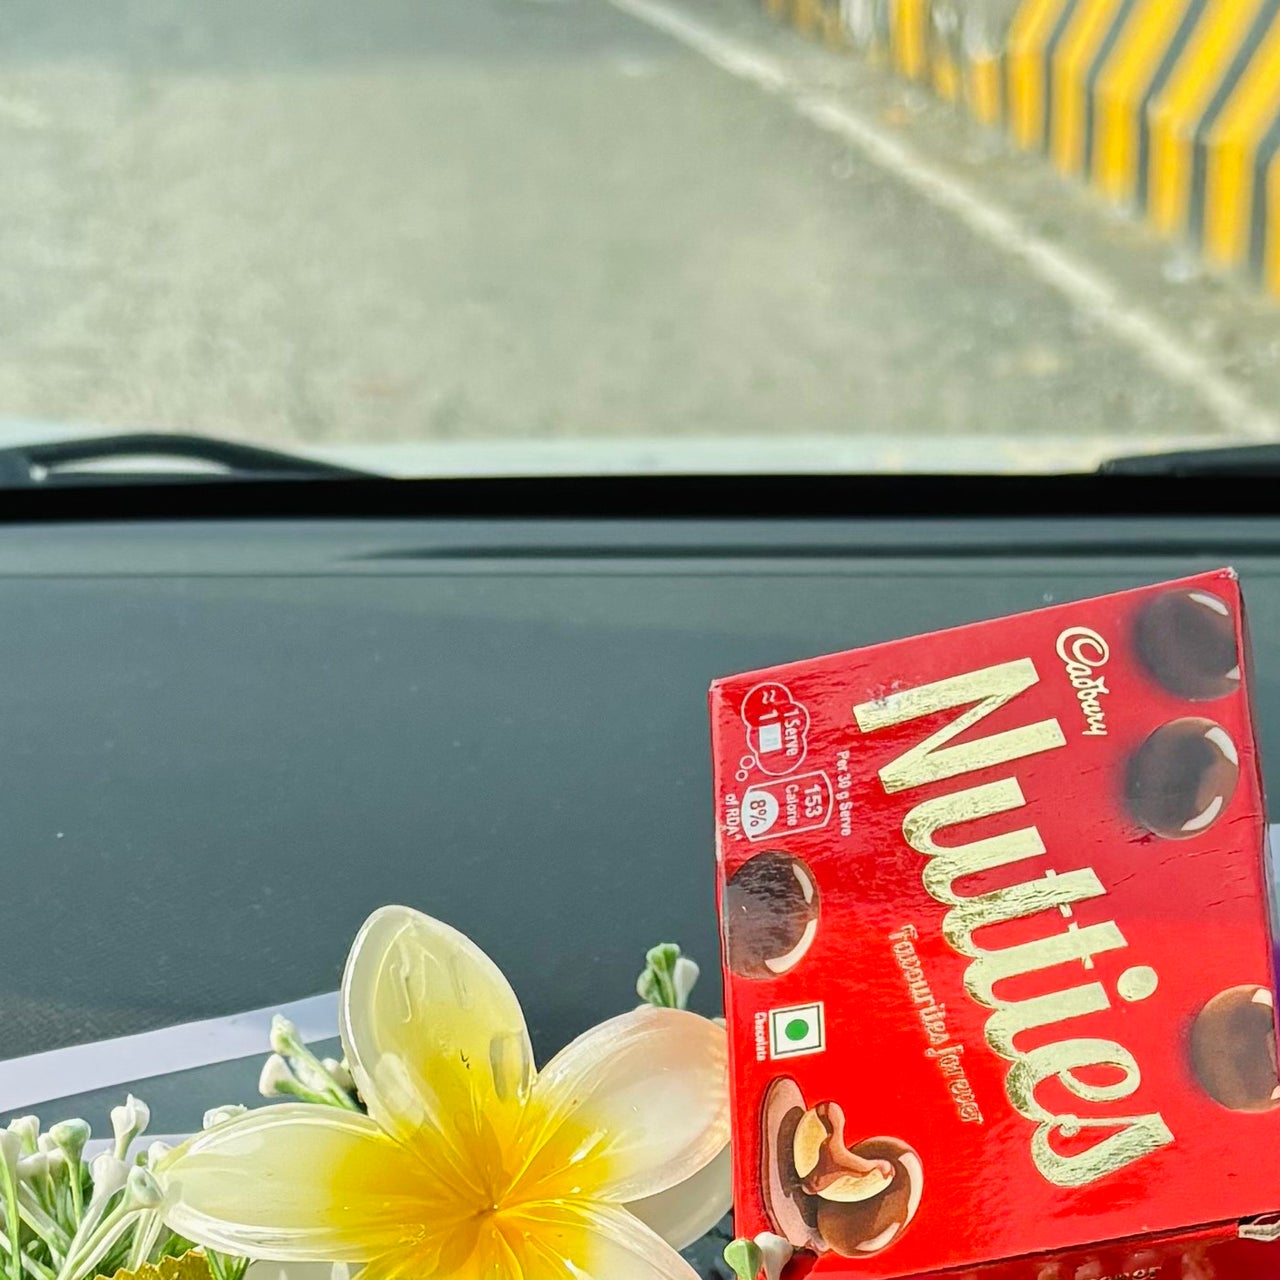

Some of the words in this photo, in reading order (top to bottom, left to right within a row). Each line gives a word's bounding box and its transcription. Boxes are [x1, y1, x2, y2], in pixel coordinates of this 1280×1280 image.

[1055, 625, 1110, 736] Cadbury
[784, 718, 801, 757] Serve
[835, 750, 851, 771] Per
[749, 799, 768, 828] 8%
[785, 784, 800, 827] Calorie
[803, 784, 824, 818] 153
[838, 801, 854, 837] Serve
[851, 656, 1175, 1188] Nutties
[888, 923, 950, 1046] Favourites
[924, 1044, 985, 1126] forever
